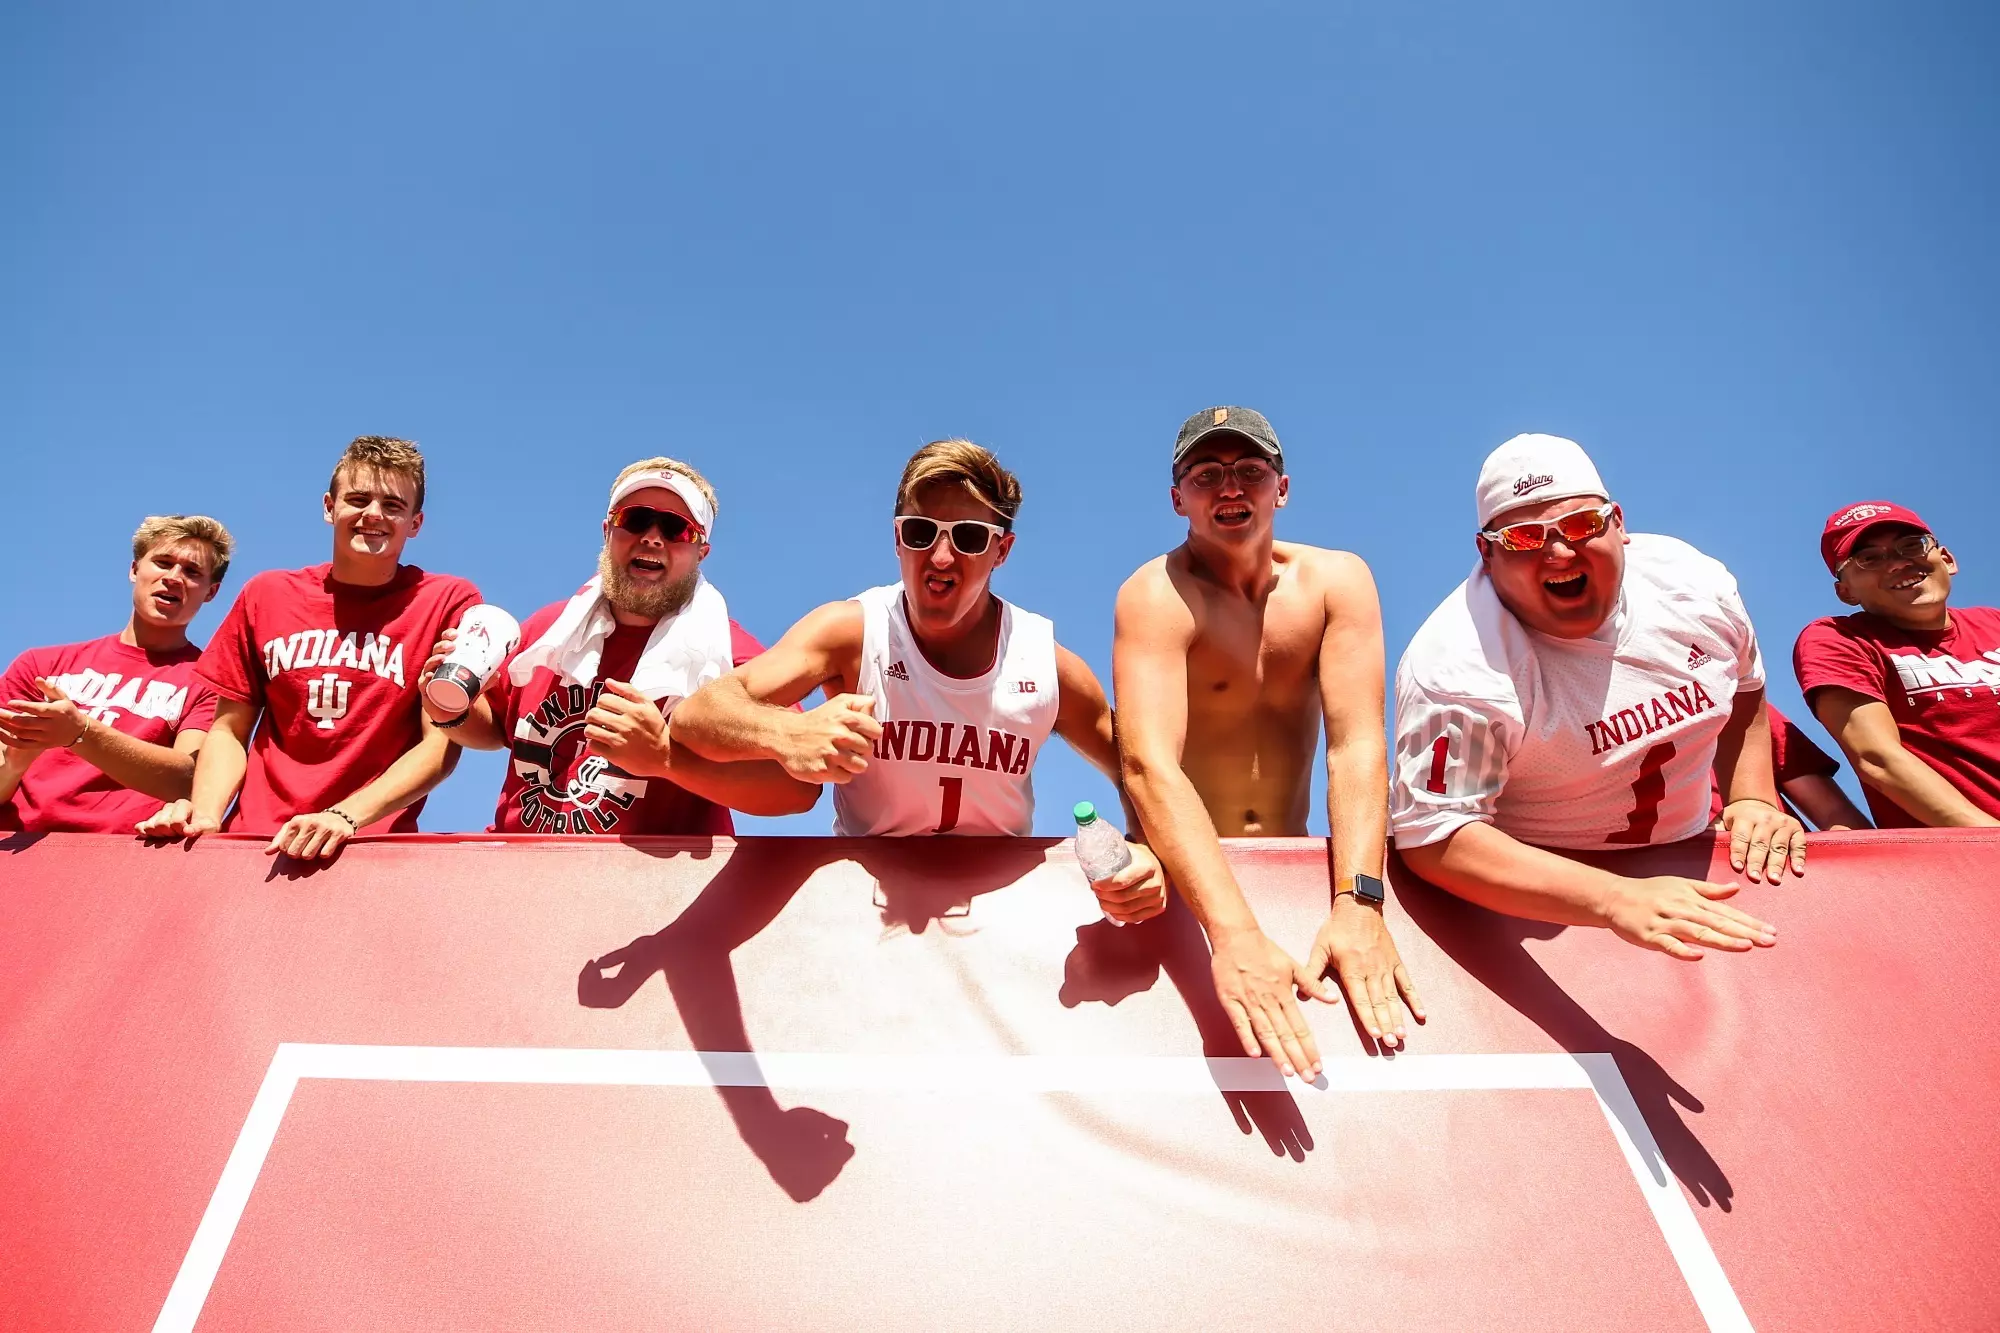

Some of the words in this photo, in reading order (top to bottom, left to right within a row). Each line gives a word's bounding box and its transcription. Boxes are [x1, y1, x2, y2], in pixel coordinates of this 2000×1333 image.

[1513, 474, 1554, 495] Indiana
[263, 629, 406, 689] INDIANA
[884, 669, 910, 682] adidas
[1687, 654, 1712, 671] adidas
[525, 681, 605, 739] INDI
[1584, 680, 1716, 756] INDIANA
[1427, 736, 1450, 795] 1
[1602, 740, 1677, 844] 1
